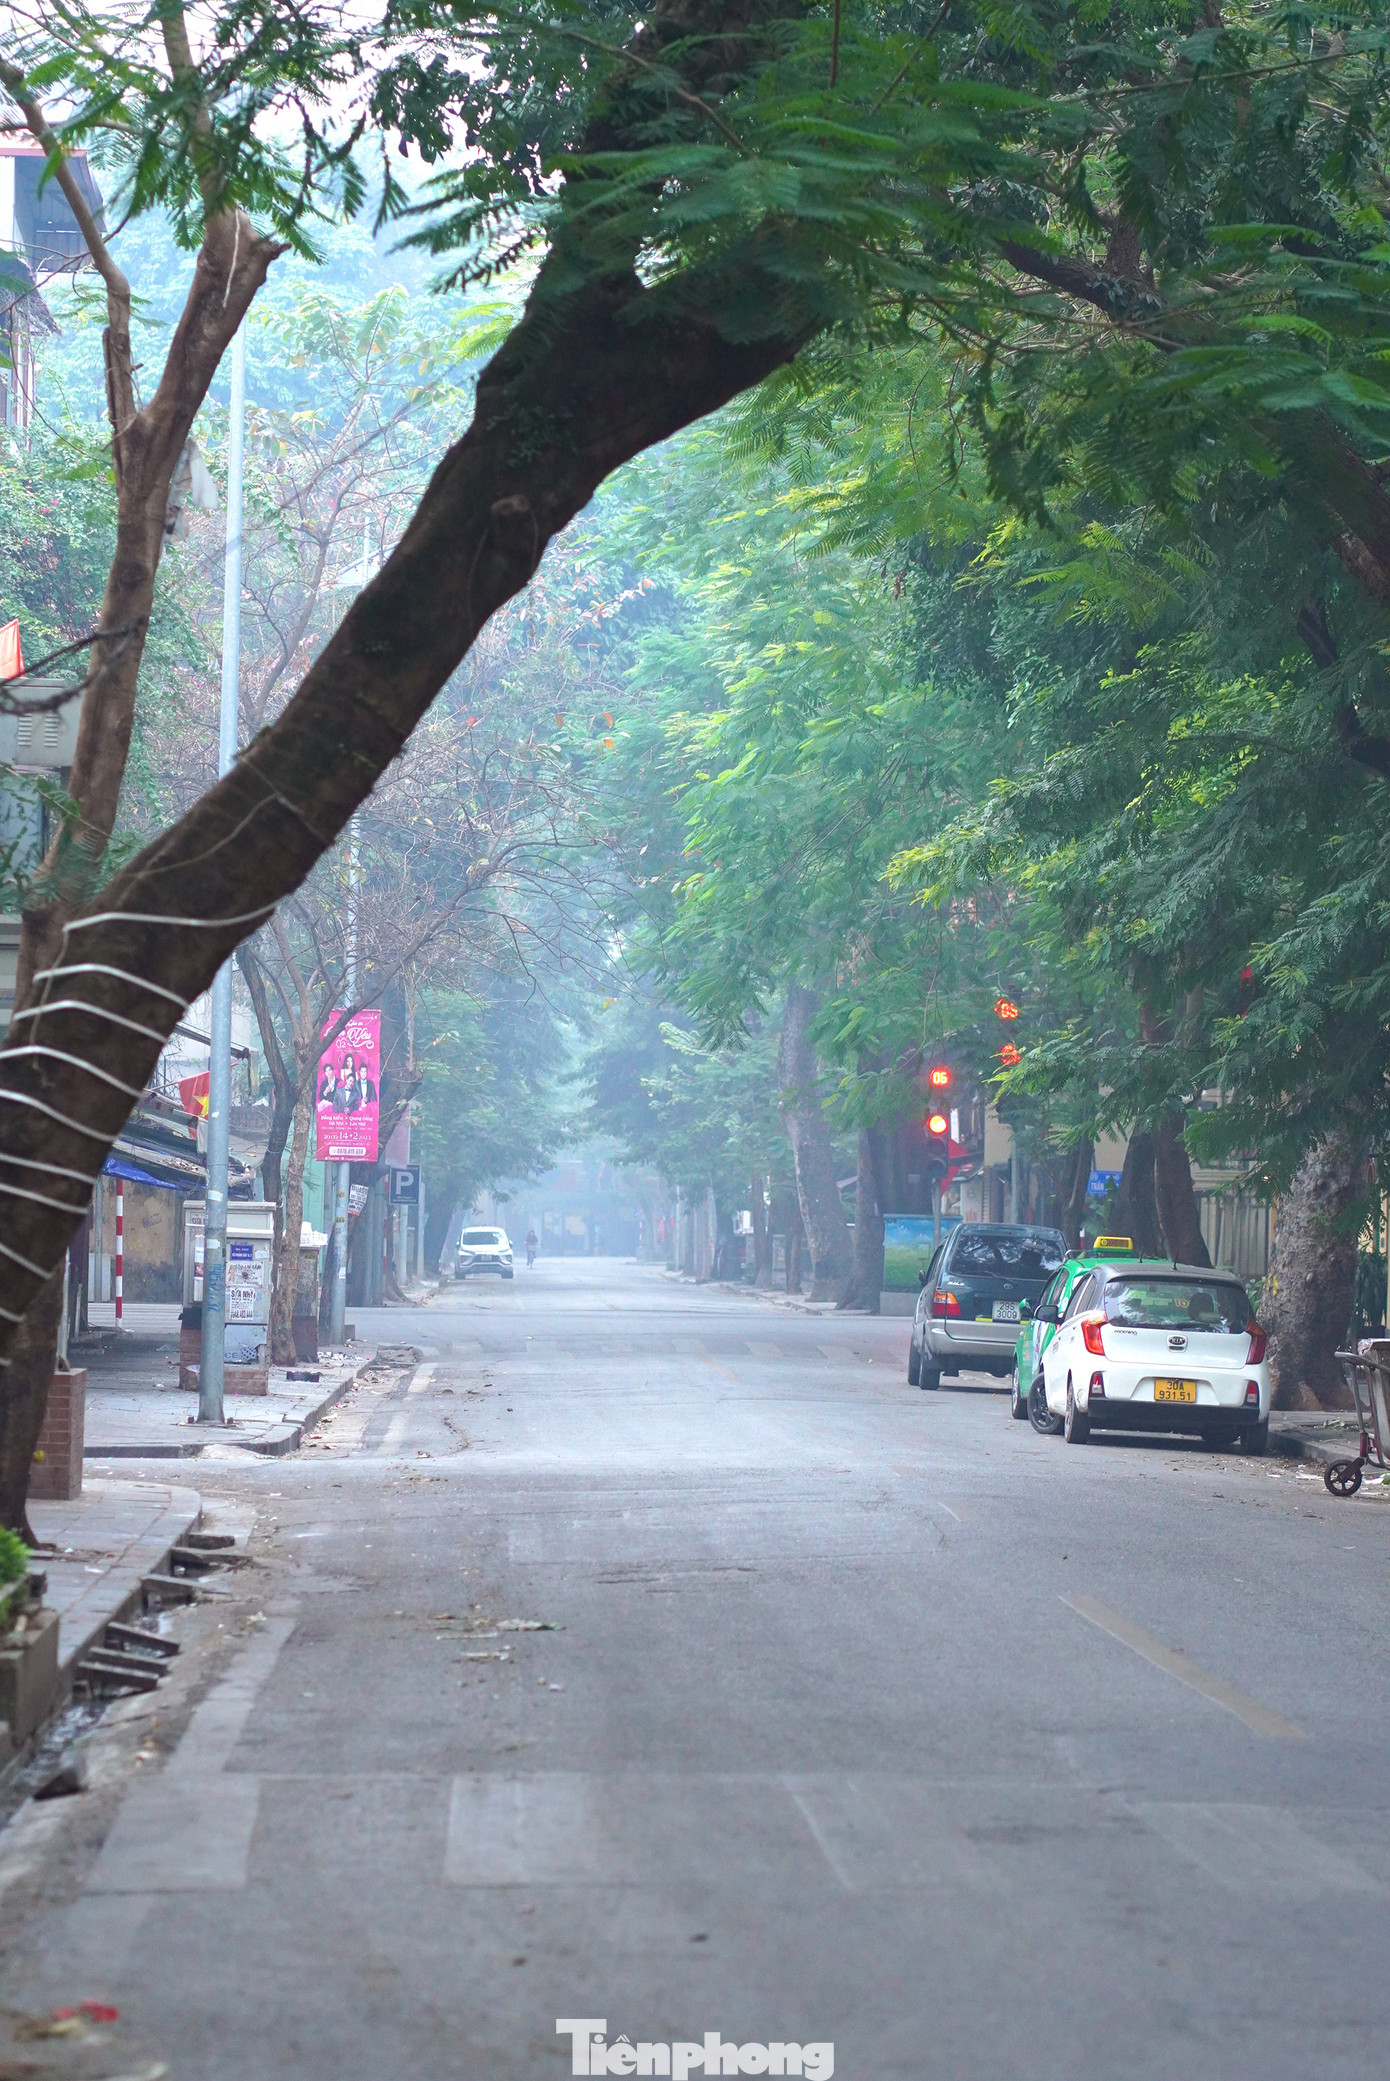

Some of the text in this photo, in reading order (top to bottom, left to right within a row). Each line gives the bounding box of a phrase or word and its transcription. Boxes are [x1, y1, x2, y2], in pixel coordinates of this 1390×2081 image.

[932, 1072, 948, 1085] 06
[395, 1171, 414, 1195] P
[1000, 1301, 1015, 1311] 29S
[996, 1310, 1018, 1319] 3009
[1166, 1381, 1185, 1391] 30A
[1158, 1390, 1192, 1401] 931.51
